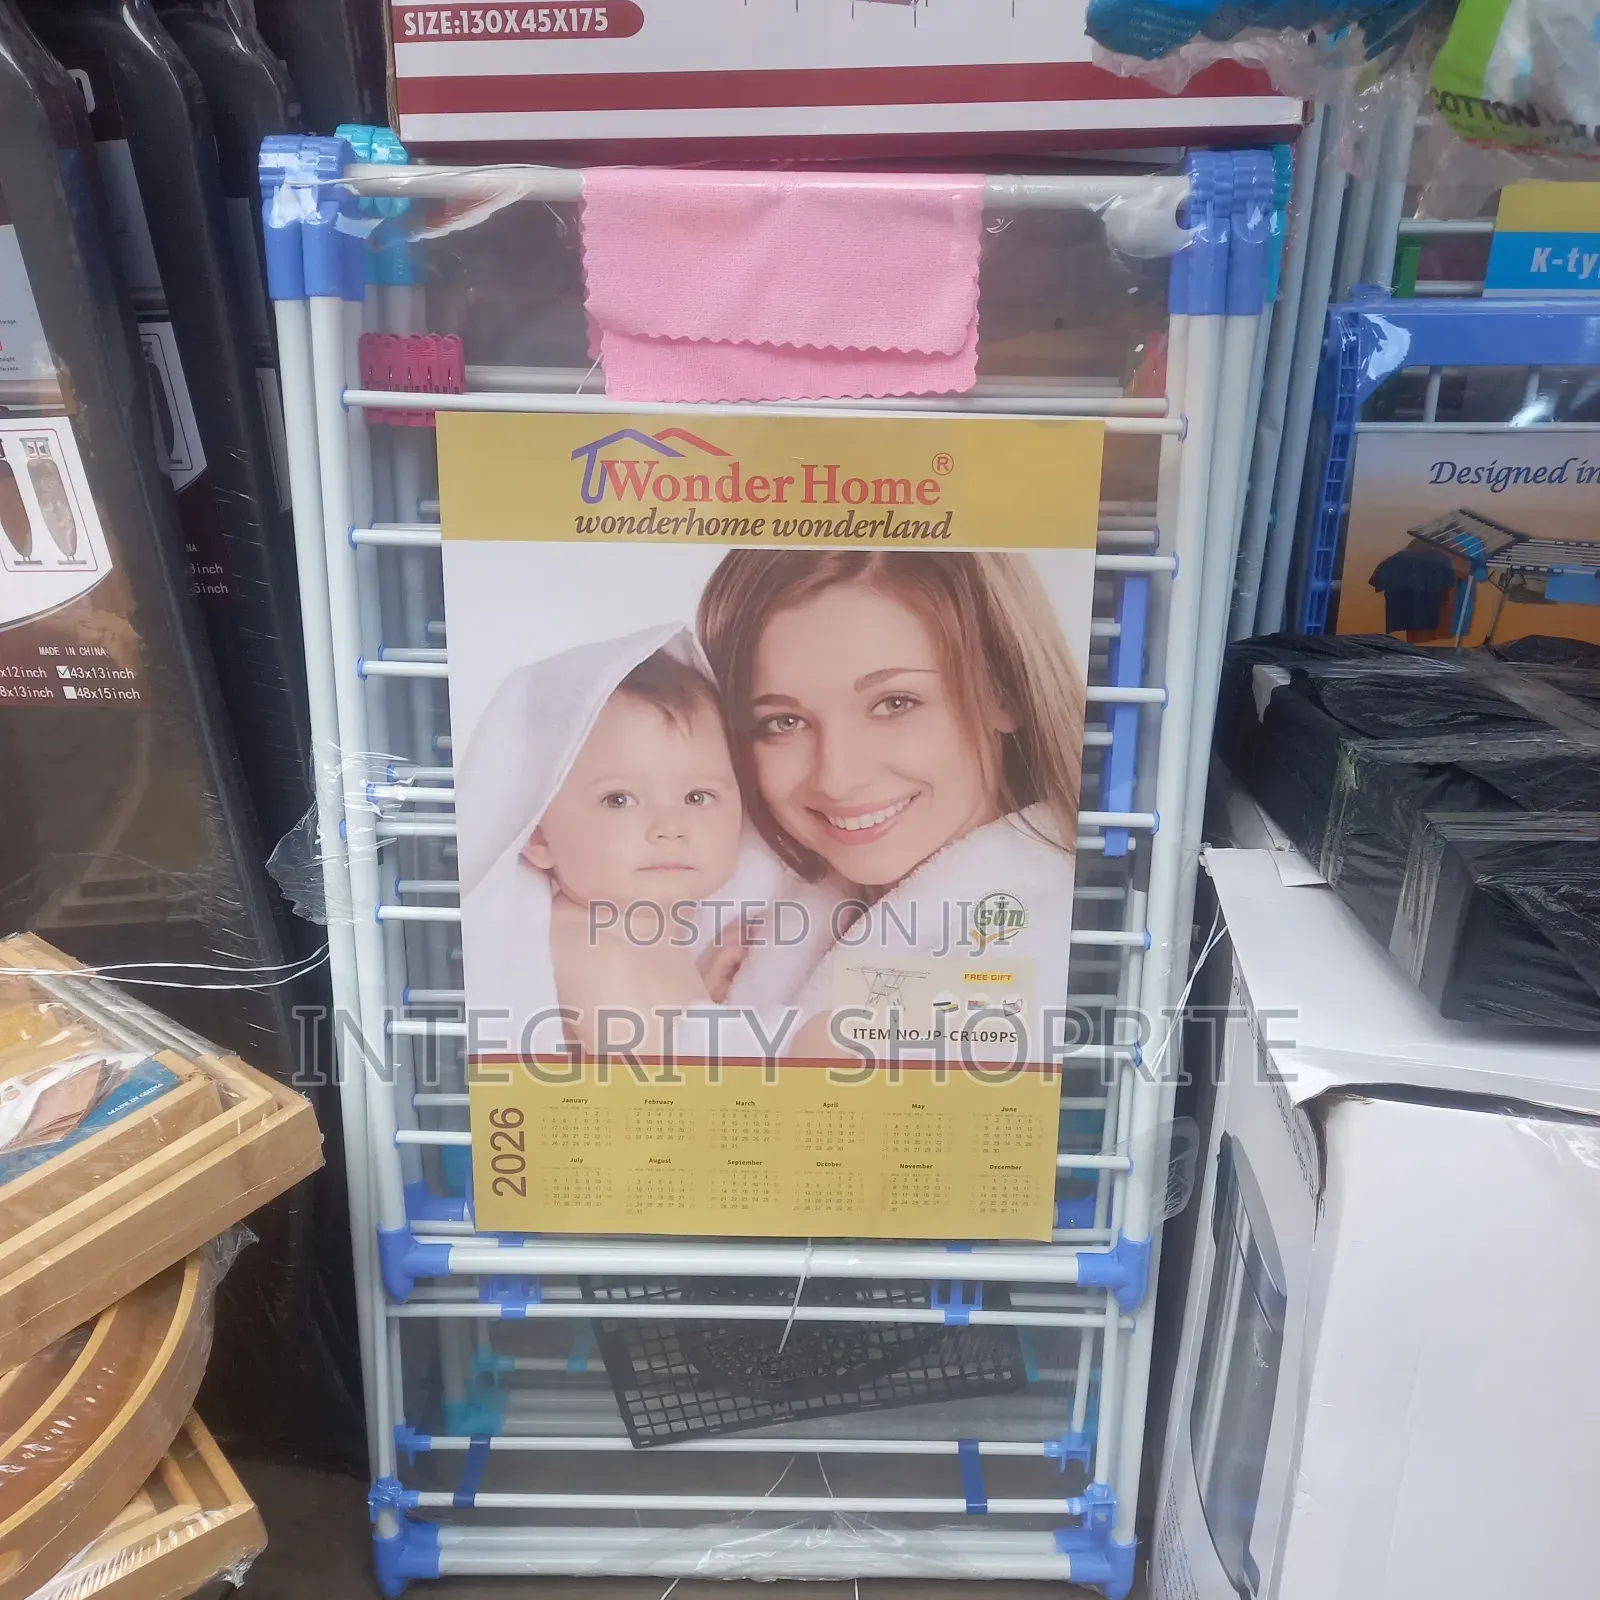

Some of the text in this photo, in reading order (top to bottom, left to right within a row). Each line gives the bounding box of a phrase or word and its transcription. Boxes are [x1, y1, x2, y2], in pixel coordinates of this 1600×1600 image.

[403, 7, 609, 36] SIZE:130X45X175
[1530, 247, 1600, 280] K-ty
[599, 459, 795, 505] Wonder
[801, 464, 942, 506] Home
[1428, 457, 1579, 494] Designed
[574, 507, 954, 539] wonderhome wonderland
[38, 646, 107, 657] MADE IN CHINA
[70, 665, 136, 680] 43x13inch
[76, 686, 141, 700] 48x15inch
[964, 973, 1013, 982] FREE GIFT
[852, 1028, 1018, 1043] ITEM NO.JP-CR109PS
[107, 1083, 164, 1116] MADE IN CHINA
[488, 1107, 527, 1198] 2026
